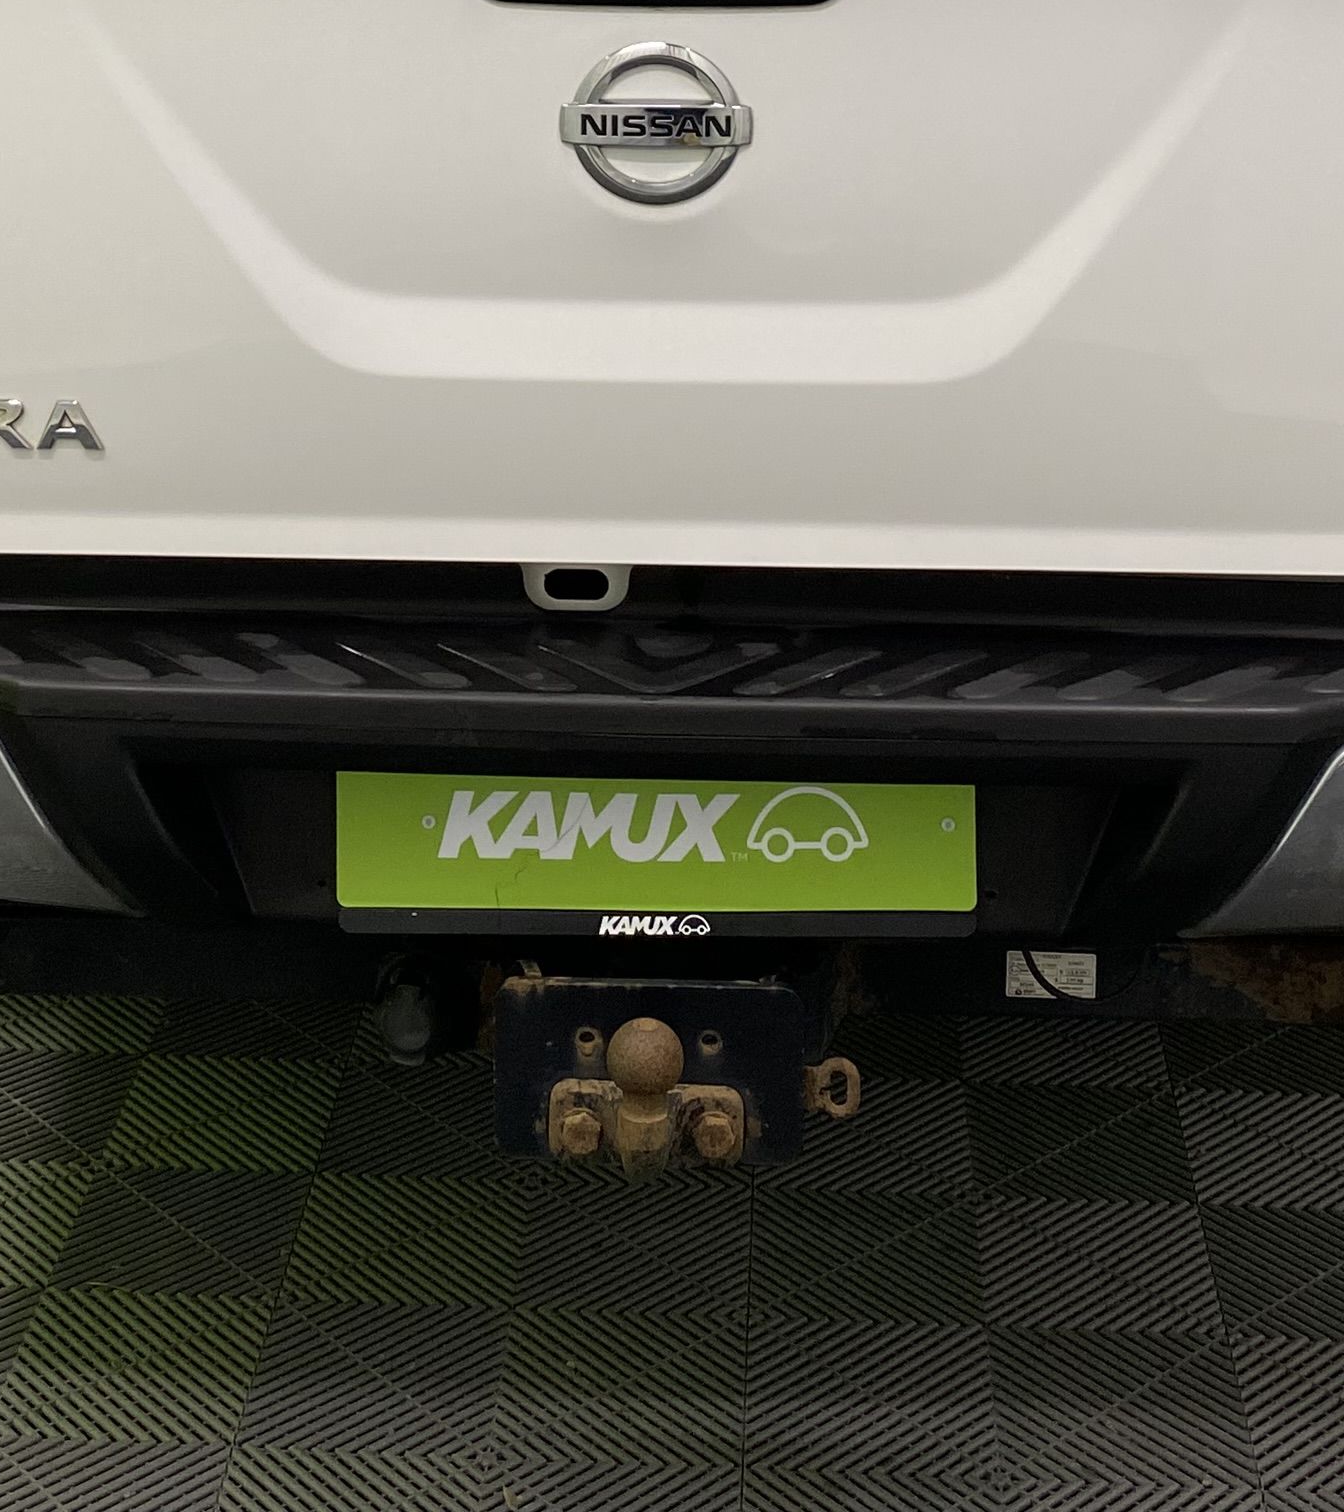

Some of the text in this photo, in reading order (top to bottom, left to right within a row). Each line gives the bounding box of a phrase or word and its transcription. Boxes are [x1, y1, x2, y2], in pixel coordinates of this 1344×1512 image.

[580, 113, 732, 138] NISSAN
[437, 789, 741, 863] KAMUX
[599, 915, 676, 936] KAMUX
